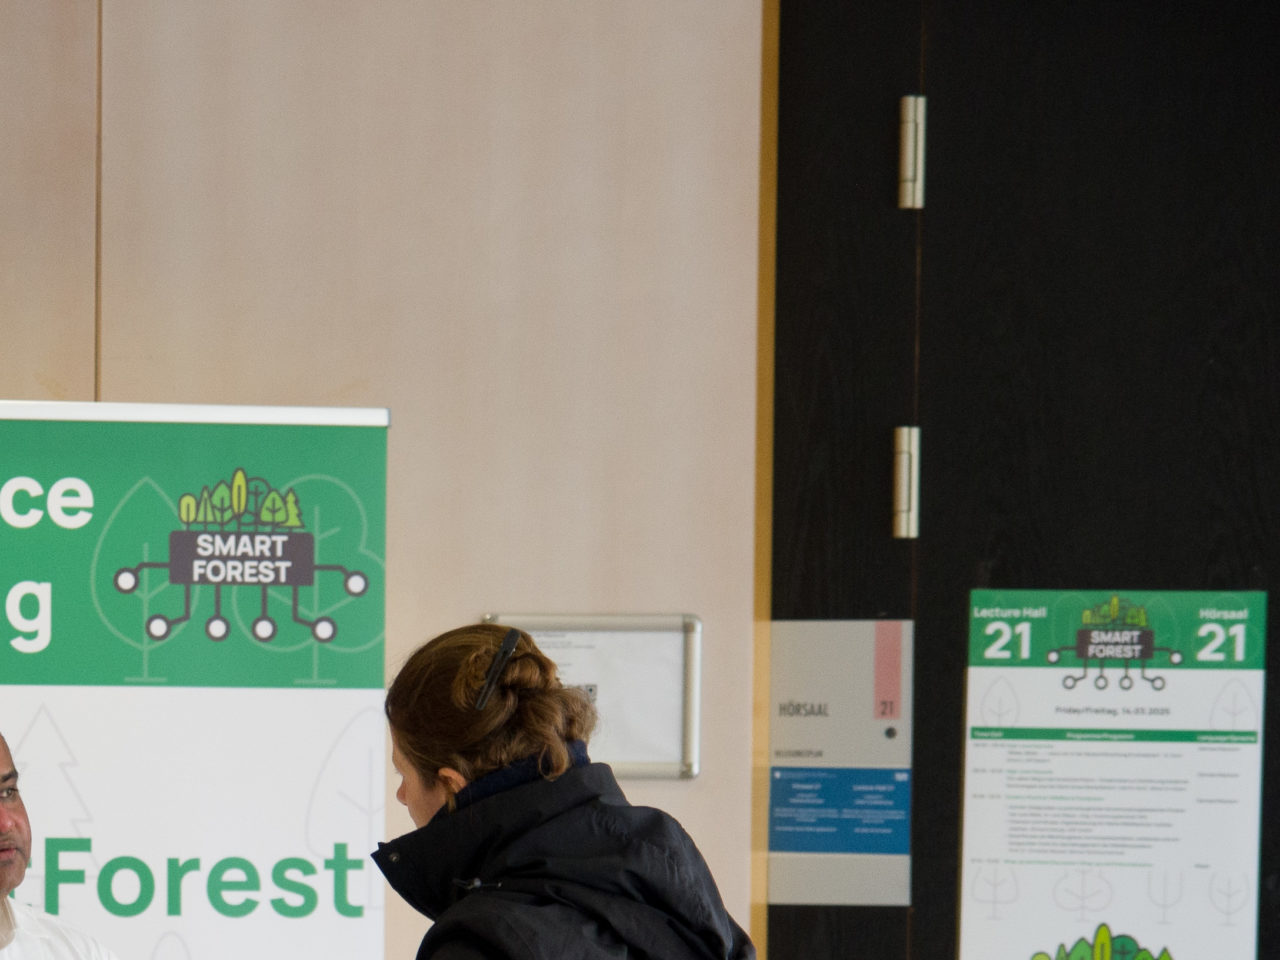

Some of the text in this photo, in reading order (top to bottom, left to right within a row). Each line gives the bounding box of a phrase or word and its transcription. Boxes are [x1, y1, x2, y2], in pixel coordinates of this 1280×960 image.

[195, 534, 289, 558] SMART
[192, 560, 292, 585] FOREST
[974, 606, 1048, 618] Lecture Hall
[983, 620, 1032, 660] 21
[1090, 630, 1141, 645] SMART
[1195, 622, 1247, 662] 21
[1087, 644, 1143, 659] FOREST
[778, 698, 894, 717] HÖRSAAL 21
[43, 836, 364, 919] Forest
